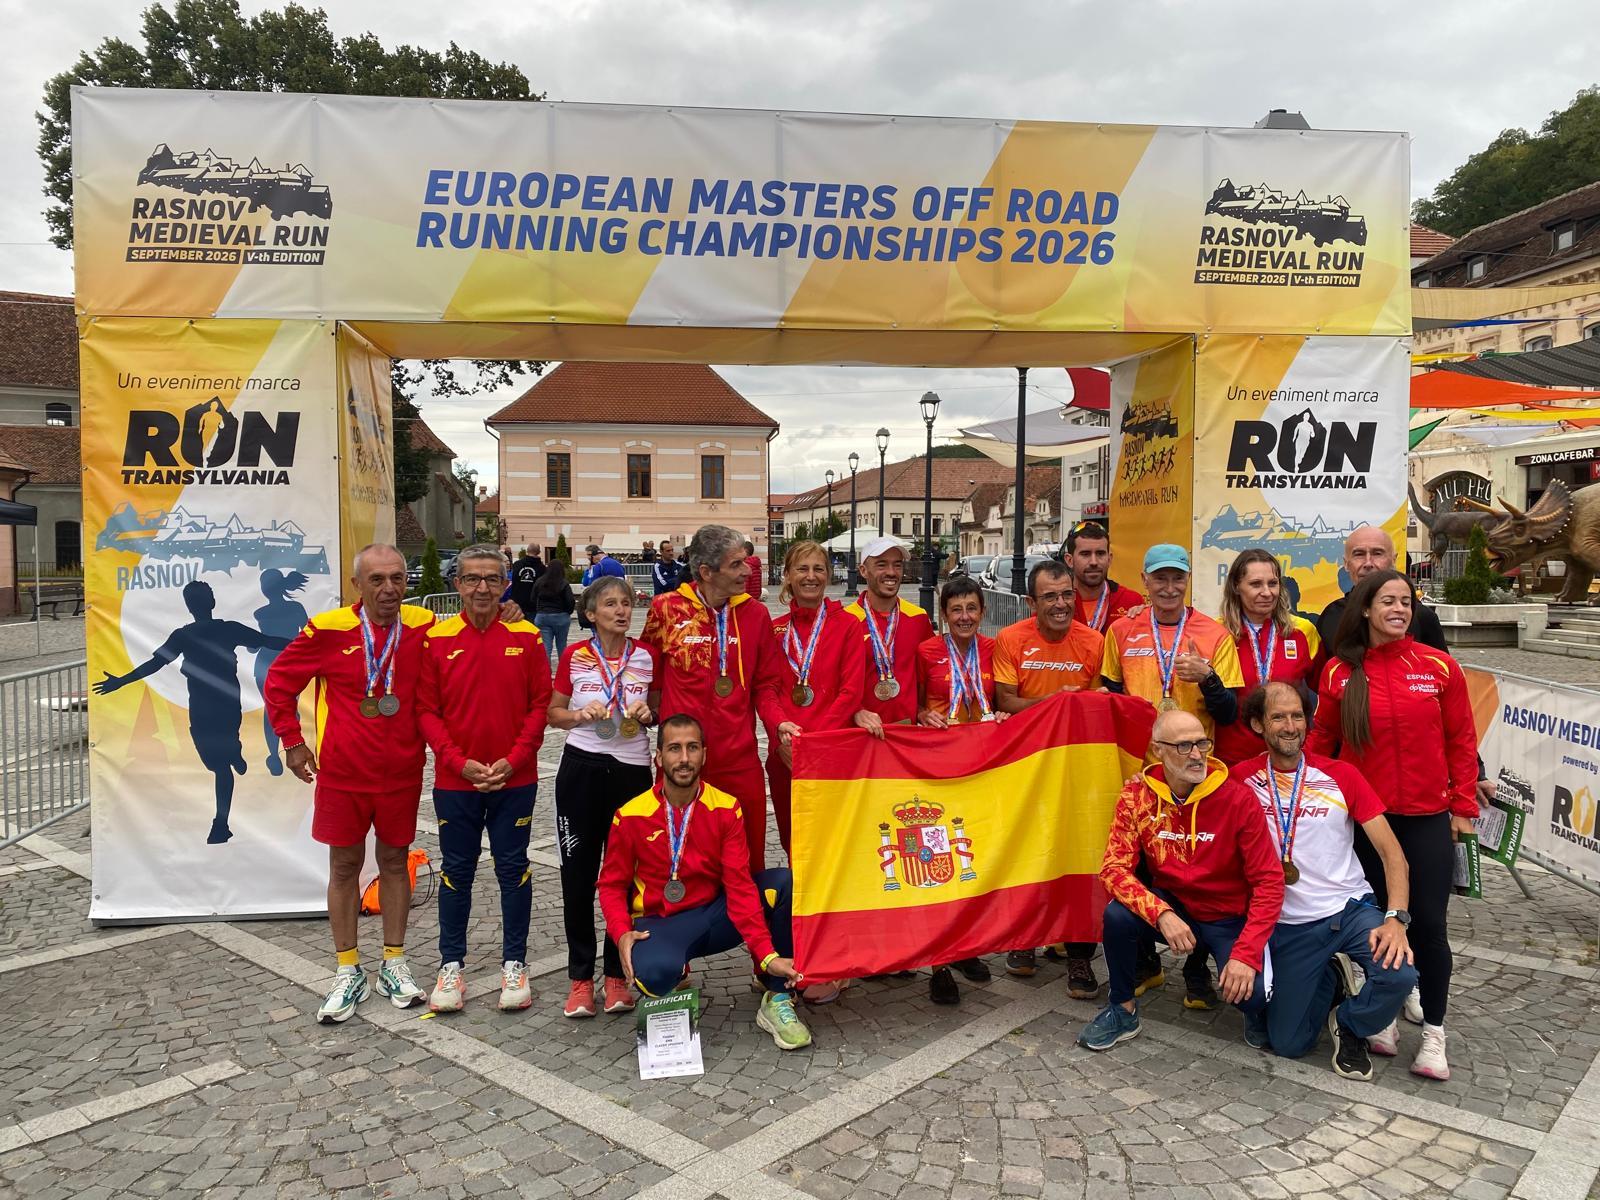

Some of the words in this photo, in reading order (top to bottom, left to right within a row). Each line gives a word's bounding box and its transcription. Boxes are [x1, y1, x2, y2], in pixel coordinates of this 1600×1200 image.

[424, 169, 674, 214] EUROPEAN
[688, 178, 898, 222] MASTERS
[912, 185, 994, 222] OFF
[1006, 188, 1120, 225] ROAD
[132, 197, 251, 222] RASNOV
[128, 222, 267, 246] MEDIEVAL
[273, 225, 330, 247] RUN
[416, 211, 628, 254] RUNNING
[637, 218, 1005, 263] CHAMPIONSHIPS
[1010, 228, 1117, 266] 2026
[1200, 226, 1294, 248] RASNOV
[131, 249, 203, 261] SEPTEMBER
[204, 250, 238, 262] 2026
[247, 251, 270, 263] V-th
[272, 252, 320, 263] EDITION
[1196, 248, 1311, 270] MEDIEVAL
[1316, 252, 1364, 271] RUN
[1198, 272, 1259, 284] SEPTEMBER
[1260, 273, 1286, 284] 2026
[1294, 275, 1315, 285] V-th
[1316, 275, 1357, 286] EDITION
[117, 372, 141, 389] Un
[147, 375, 243, 390] eveniment
[246, 377, 301, 391] marca
[1226, 385, 1248, 402] Un
[1251, 387, 1329, 402] eveniment
[1332, 389, 1379, 403] marca
[1530, 455, 1553, 465] ZONA
[121, 469, 290, 486] TRANSYLVANIA
[1225, 474, 1367, 489] TRANSYLVANIA
[117, 562, 199, 591] RASNOV
[1020, 660, 1084, 673] ESPAÑA
[1406, 673, 1436, 681] ESPAÑA
[1503, 703, 1558, 737] RASNOV
[1562, 755, 1590, 770] powered
[1589, 762, 1599, 775] by
[1504, 813, 1522, 861] CERTIFICATE
[1471, 839, 1480, 893] CERTIFICATE
[644, 992, 693, 1008] CERTIFICATE
